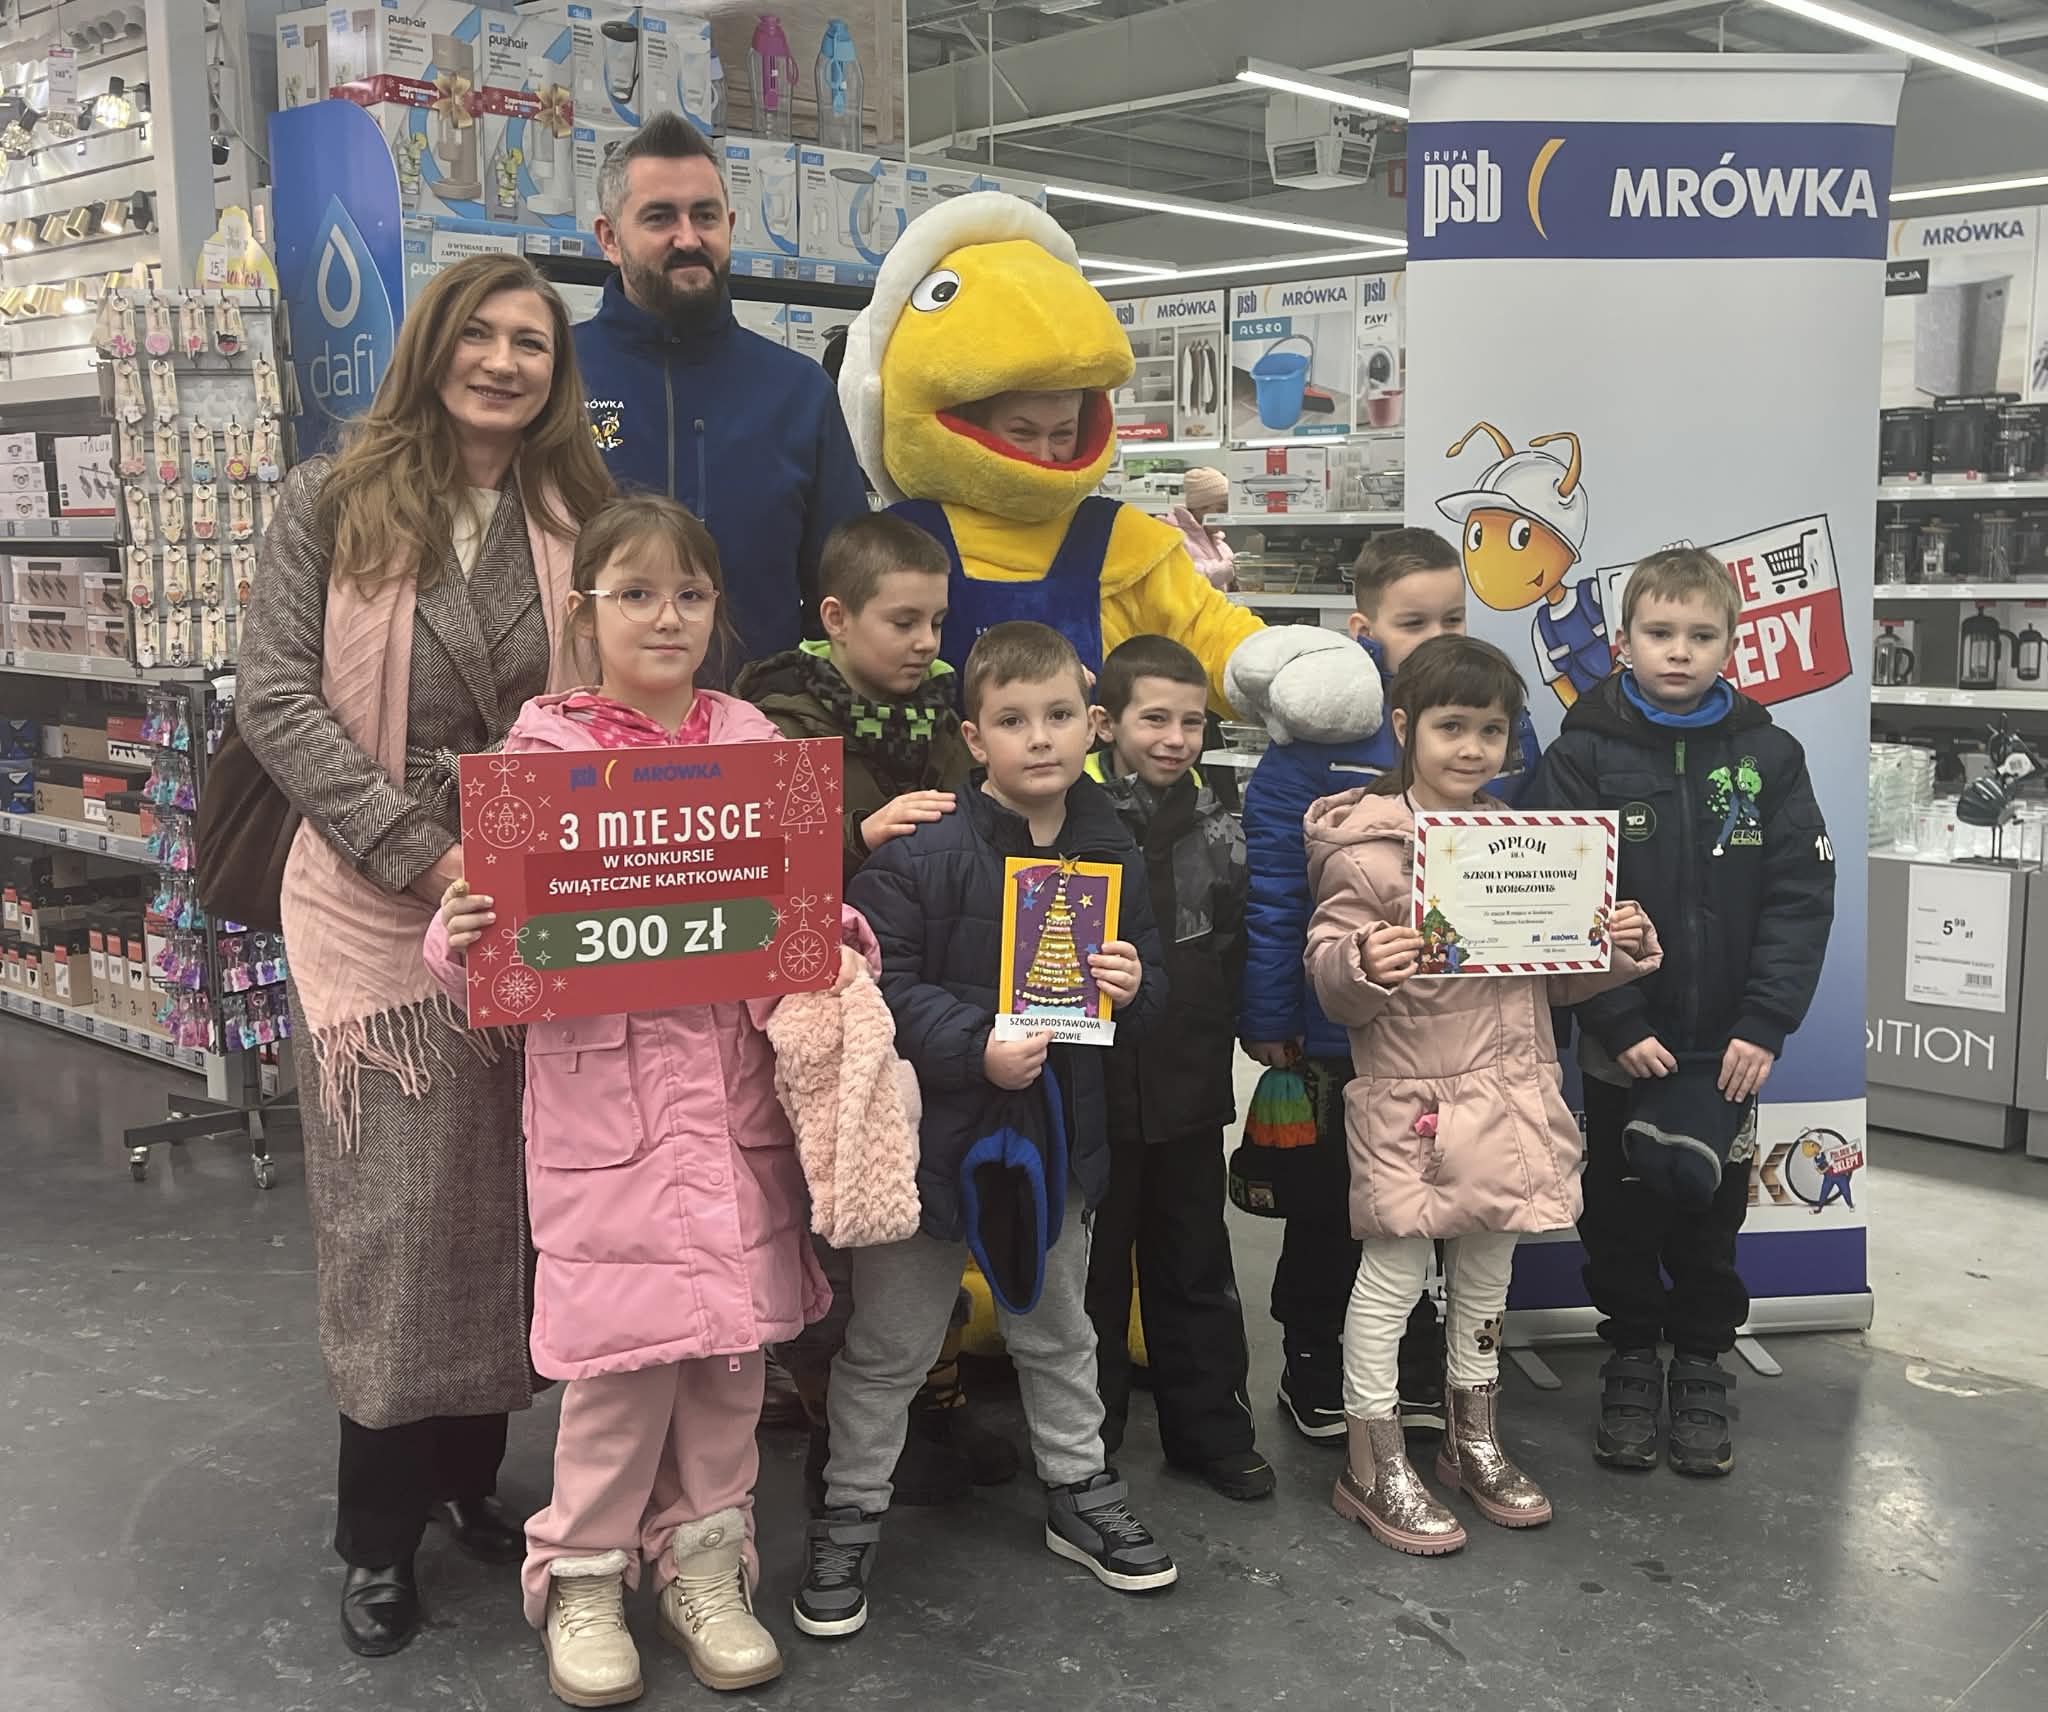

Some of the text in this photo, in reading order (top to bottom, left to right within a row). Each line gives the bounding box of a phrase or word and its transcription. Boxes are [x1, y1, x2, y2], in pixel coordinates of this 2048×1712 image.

[1424, 150, 1467, 161] GRUPA
[1424, 150, 1878, 237] psb MRÓWKA
[1922, 220, 2025, 247] MRÓWKA
[1237, 285, 1348, 318] psb MRÓWKA
[1364, 277, 1386, 307] psb
[1157, 298, 1217, 319] MRÓWKA
[311, 333, 375, 397] dafi
[584, 399, 625, 409] RÓWKA
[1728, 605, 1815, 689] EPY
[634, 762, 721, 783] MRÓWKA
[559, 802, 762, 851] 3 MIEJSCE
[603, 848, 715, 869] W KONKURSIE
[1815, 835, 1834, 861] 10
[548, 875, 652, 897] ŚWIĄTECZNE
[655, 866, 769, 889] KARTKOWANIE
[575, 907, 727, 963] 300 zł
[1943, 920, 1954, 936] 5
[1010, 1017, 1101, 1030] SZKOŁA PODSTAWOWA
[1026, 1031, 1034, 1039] W
